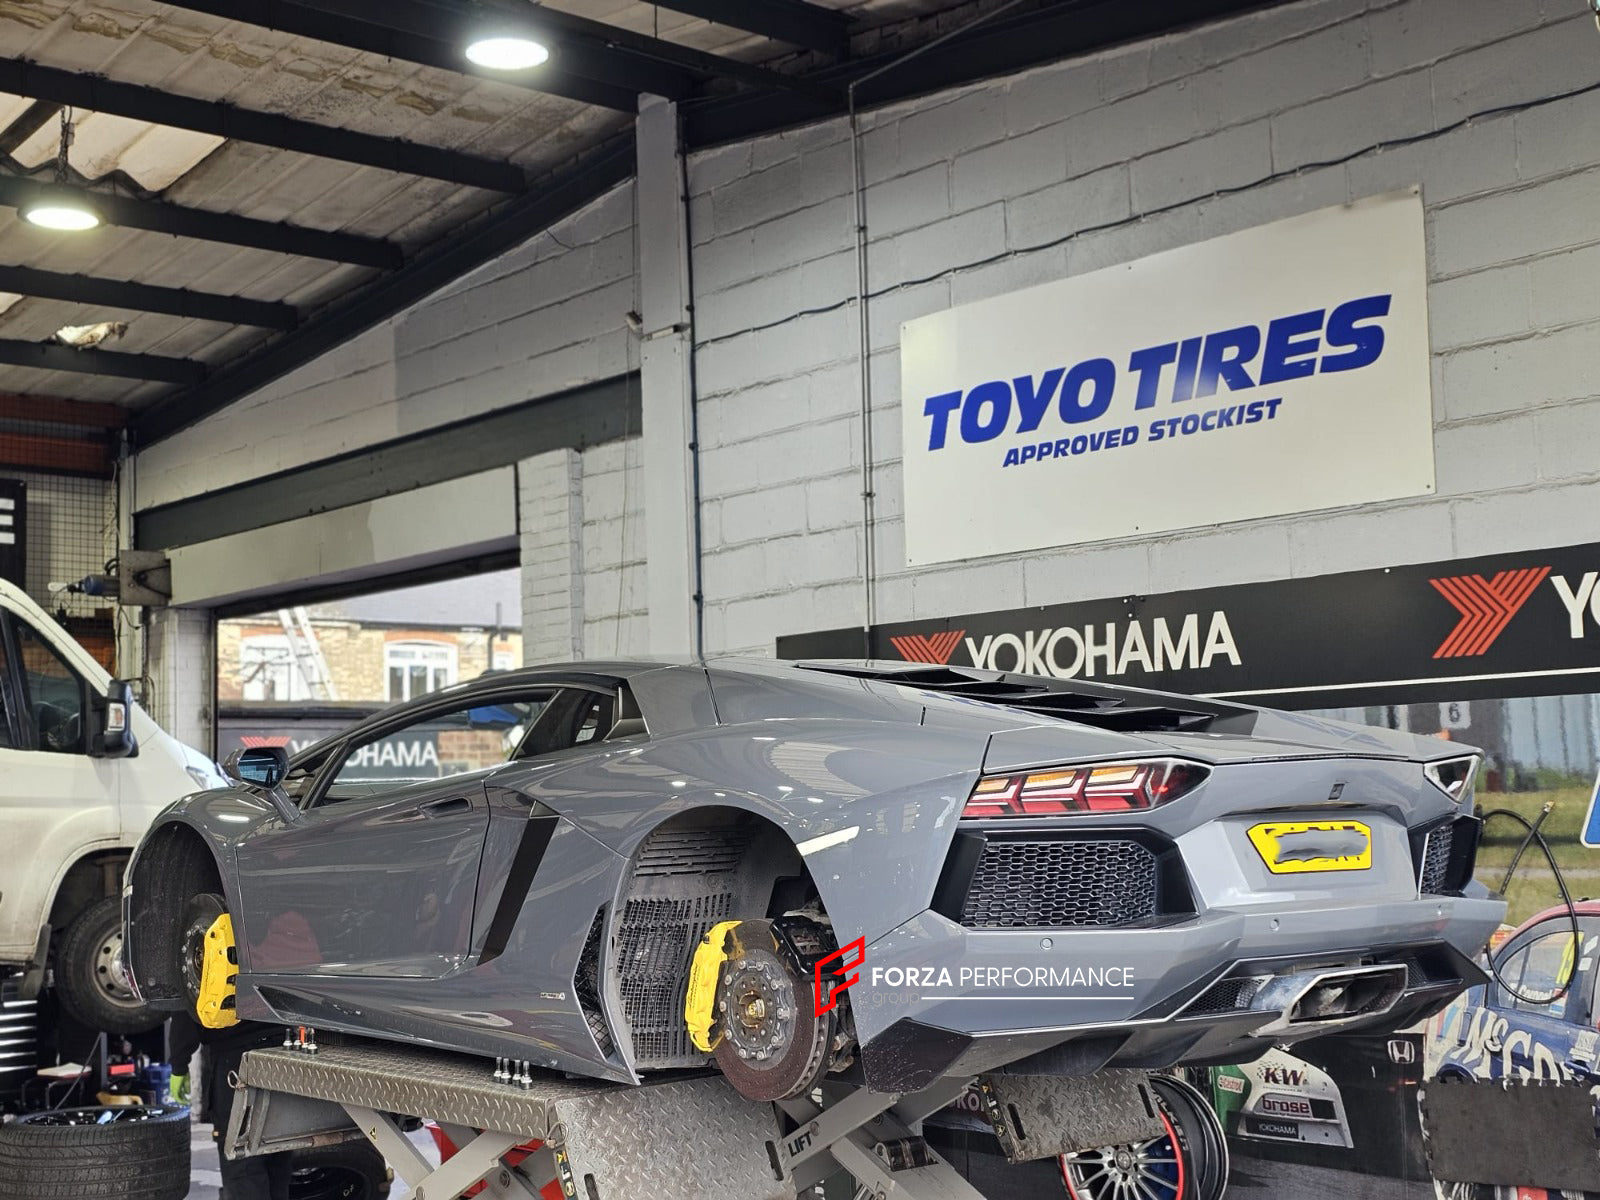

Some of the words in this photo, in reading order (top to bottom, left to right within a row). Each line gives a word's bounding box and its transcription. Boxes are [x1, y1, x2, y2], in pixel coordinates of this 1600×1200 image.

[923, 357, 1116, 452] TOYO
[1128, 294, 1392, 411] TIRES
[1002, 425, 1139, 467] APPROVED
[1148, 398, 1282, 442] STOCKIST
[964, 610, 1242, 679] YOKOHAMA
[1264, 1067, 1304, 1086] KW
[1262, 1096, 1310, 1113] brose
[787, 1131, 813, 1157] LIFT
